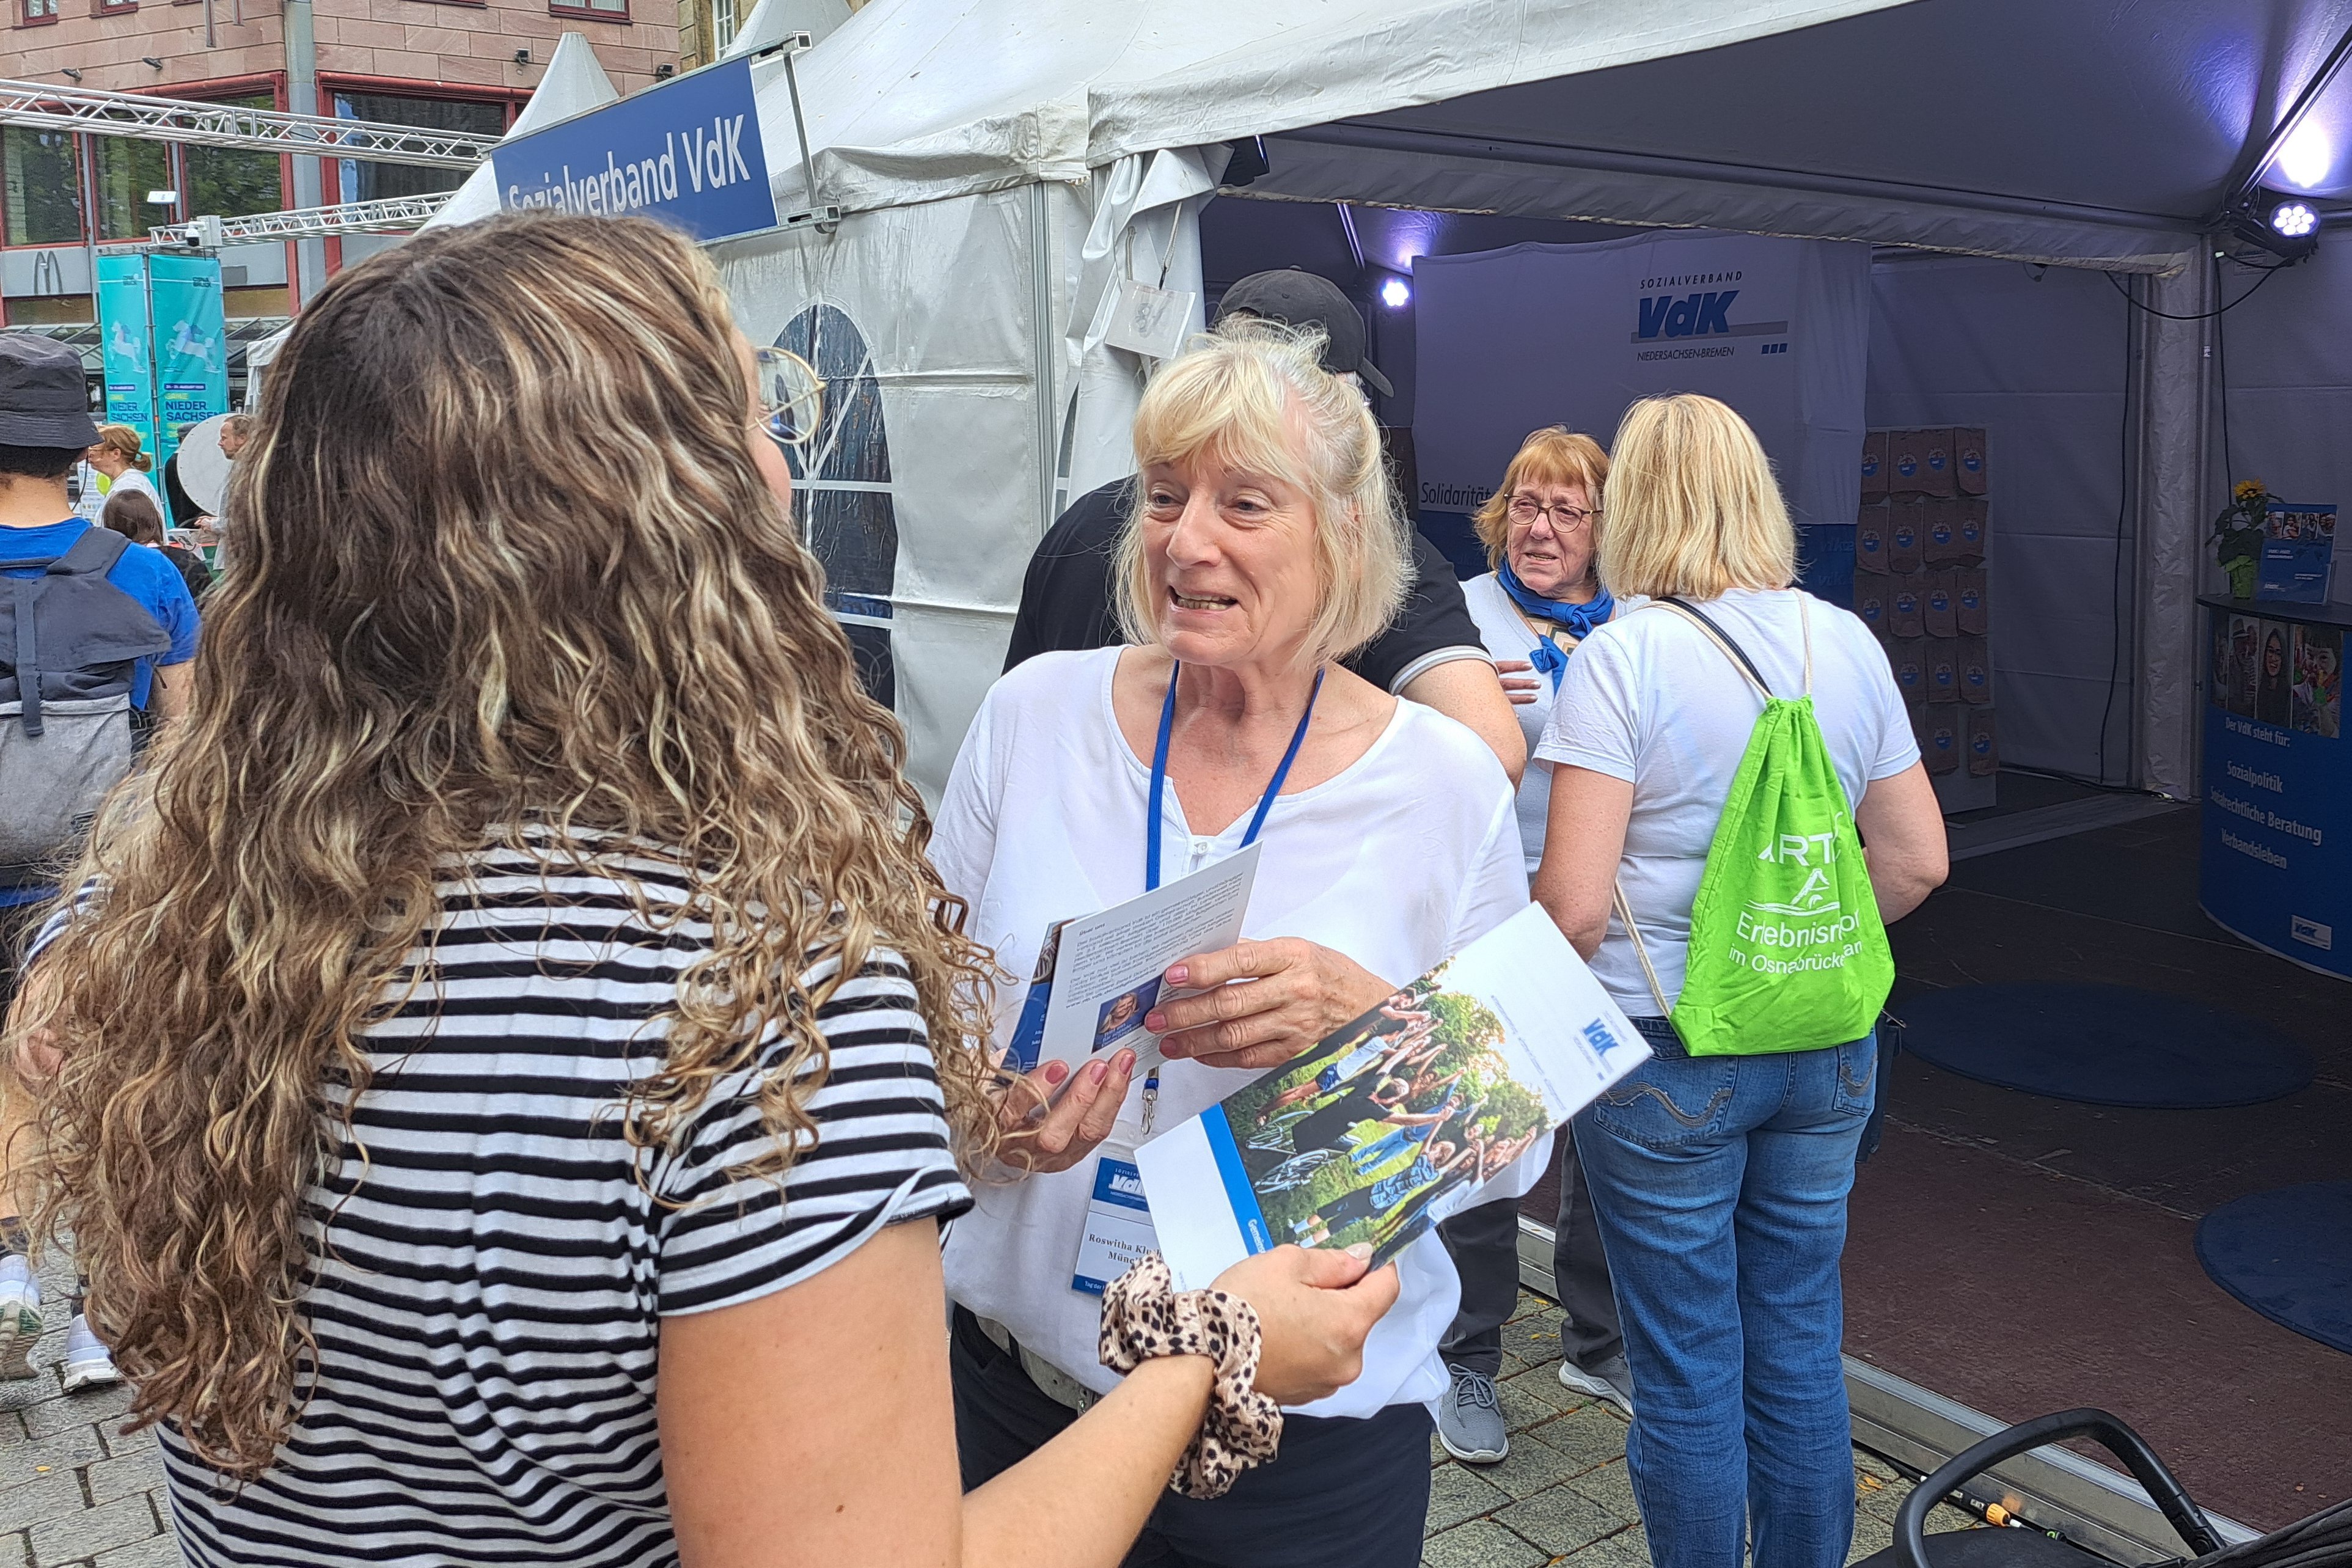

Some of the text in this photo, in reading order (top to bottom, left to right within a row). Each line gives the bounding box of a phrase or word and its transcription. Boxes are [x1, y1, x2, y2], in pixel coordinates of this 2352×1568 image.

[509, 114, 751, 216] Sozialverband VdK
[1640, 271, 1742, 290] SOZIALVERBAND
[1638, 290, 1740, 339] VdK
[1637, 346, 1735, 361] NIEDERSACHSEN-BREMEN
[165, 401, 207, 411] NIEDER
[1421, 482, 1491, 507] Solidarität
[2226, 717, 2290, 747] Der VdK steht für:
[2227, 760, 2283, 794] Sozialpolitik
[2268, 811, 2322, 846] Beratung
[2221, 827, 2287, 870] Verbandsleben
[1729, 943, 1746, 965] im
[1583, 1017, 1619, 1057] VdK
[1089, 1233, 1132, 1251] Roswitha
